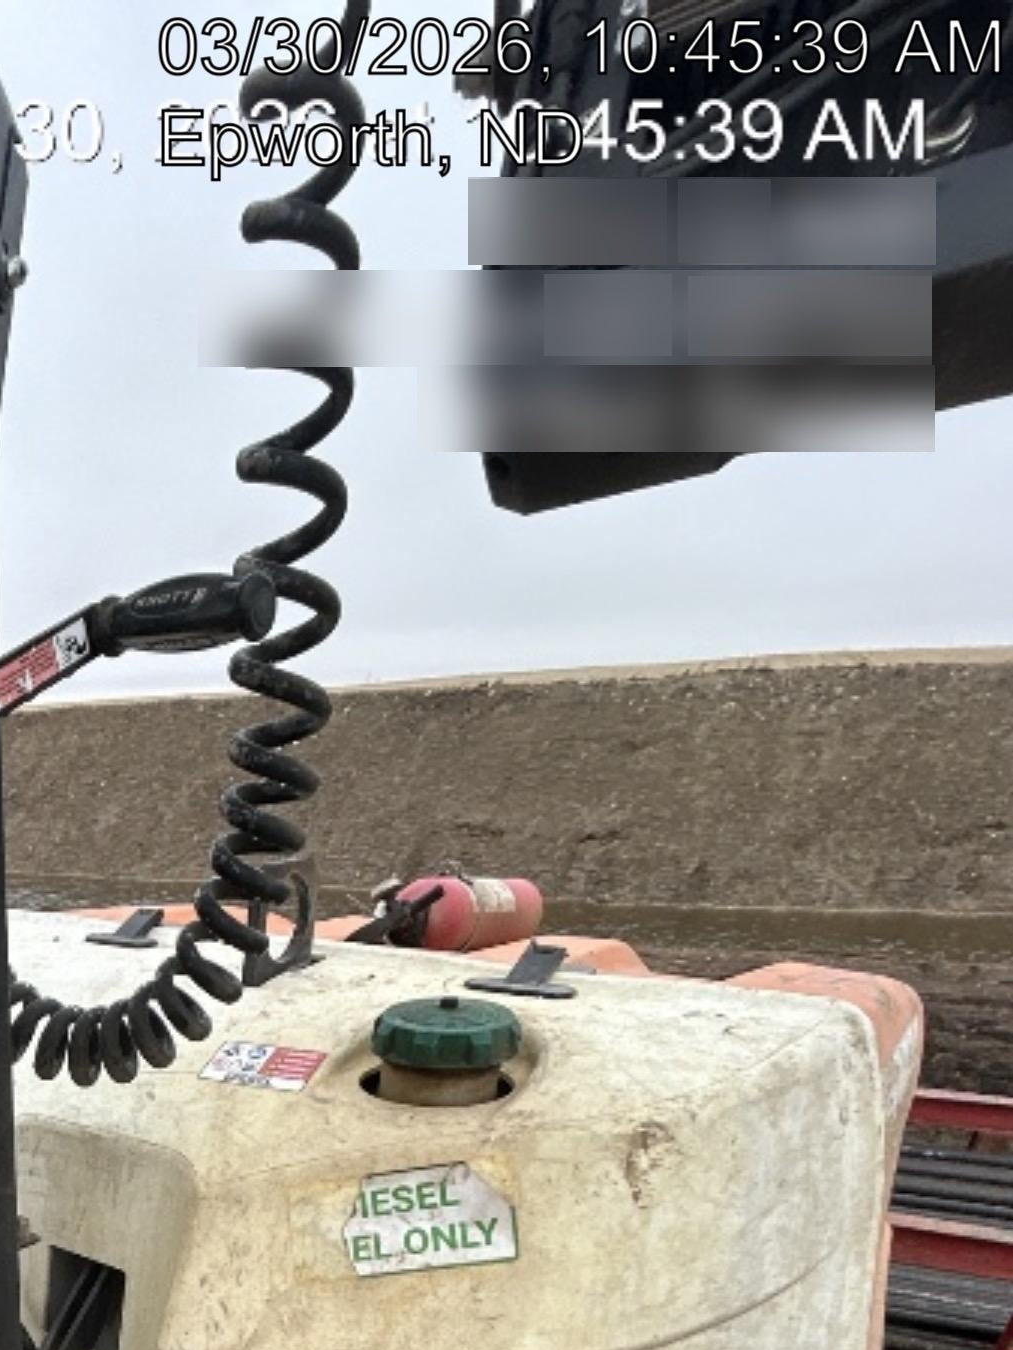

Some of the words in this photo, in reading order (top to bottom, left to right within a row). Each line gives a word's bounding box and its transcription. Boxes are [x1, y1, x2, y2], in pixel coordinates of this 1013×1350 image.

[357, 1181, 462, 1219] IESEL
[351, 1232, 392, 1263] EL
[403, 1217, 499, 1255] ONLY
